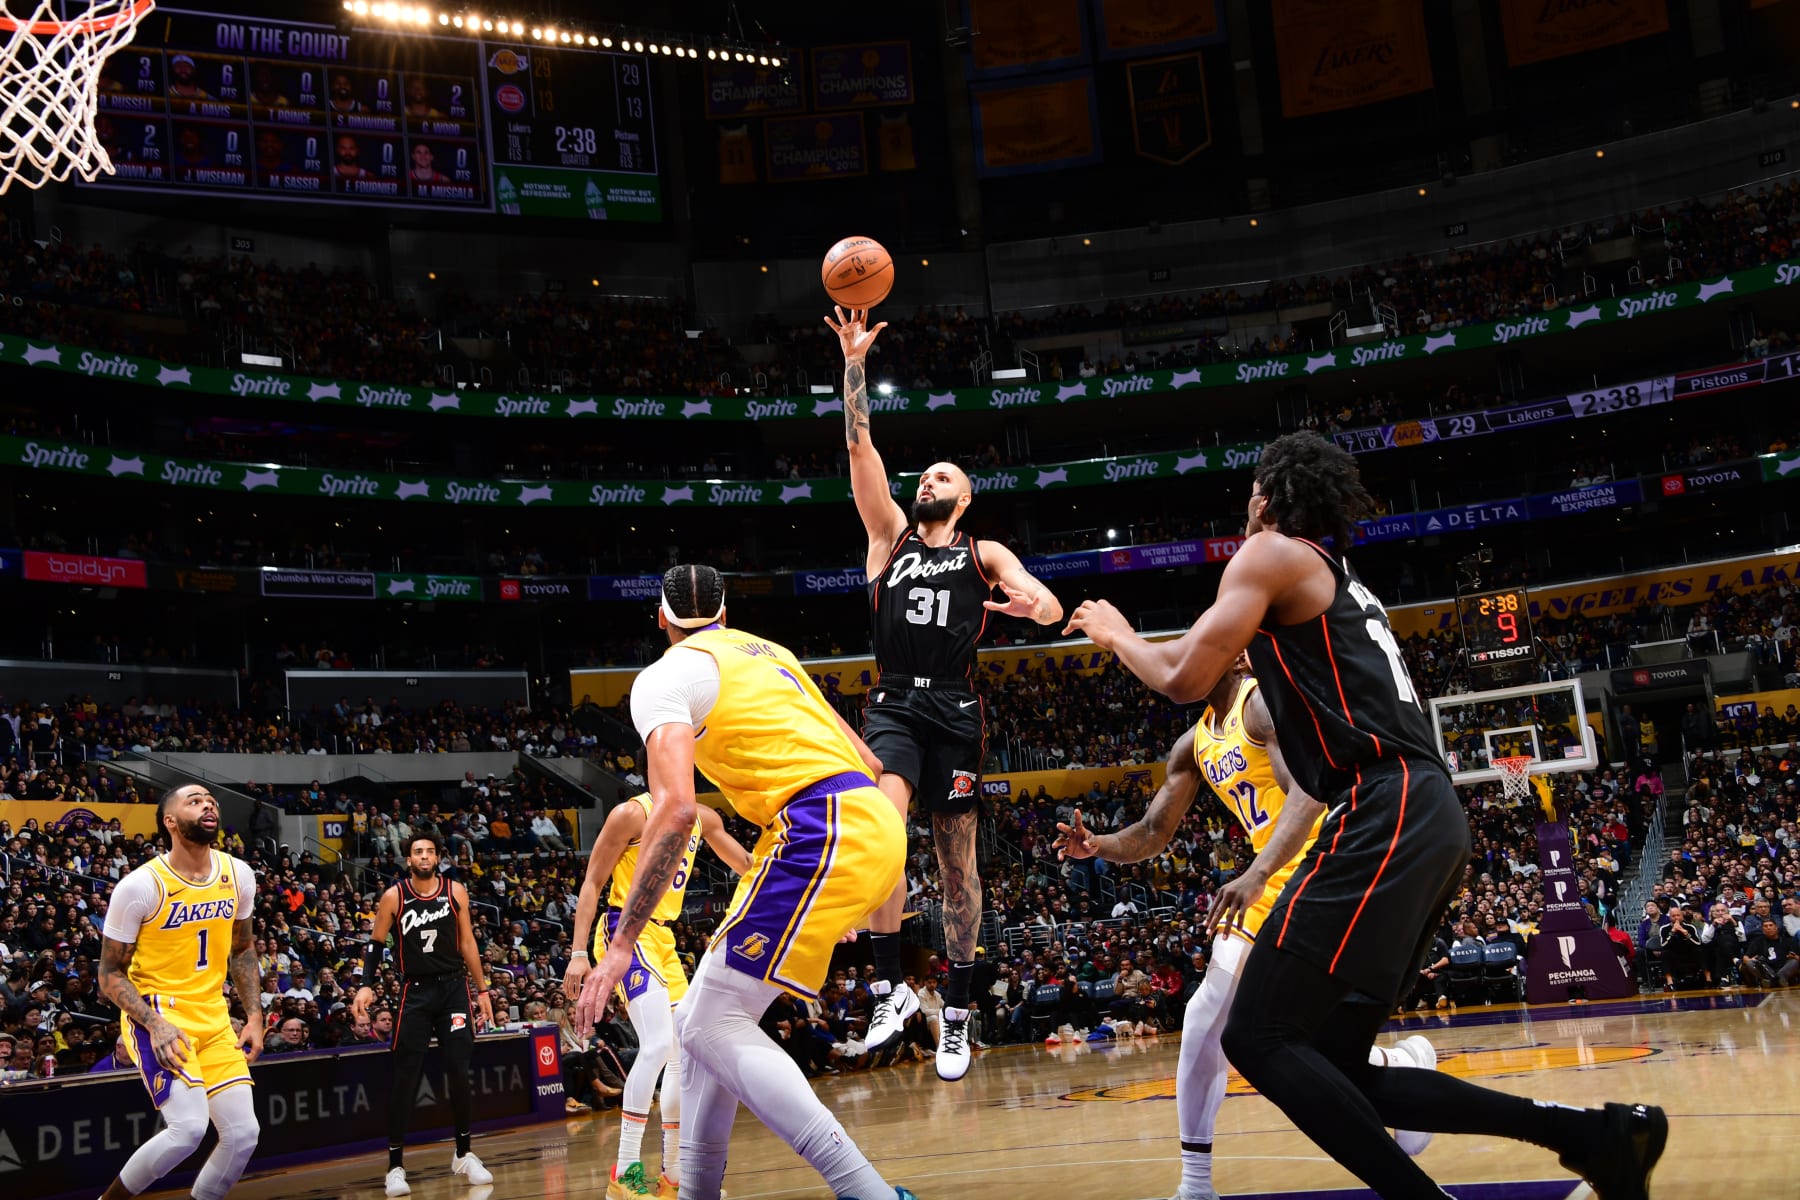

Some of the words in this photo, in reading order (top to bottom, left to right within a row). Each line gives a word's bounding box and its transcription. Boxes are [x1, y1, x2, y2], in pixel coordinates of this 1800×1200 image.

[216, 22, 245, 50] ON
[249, 26, 285, 55] THE
[288, 30, 350, 60] COURT
[139, 56, 151, 79] 3
[222, 64, 233, 86] 6
[622, 63, 640, 87] 29
[220, 86, 238, 99] PTS
[301, 71, 312, 94] 0
[377, 79, 389, 100] 0
[819, 73, 906, 95] CHAMPIONS
[111, 94, 154, 112] RUSSELL
[451, 84, 463, 106] 2
[201, 103, 232, 118] DAVIS
[626, 95, 643, 119] 13
[144, 124, 156, 147] 2
[226, 130, 239, 152] 0
[554, 125, 598, 155] 2:38
[305, 137, 318, 159] 0
[382, 142, 394, 163] 0
[456, 148, 468, 169] 0
[773, 145, 860, 166] CHAMPIONS
[195, 170, 246, 186] WISEMAN
[283, 176, 320, 191] SASSER
[355, 179, 398, 196] FOURNIER
[431, 185, 475, 201] MUSCALA
[234, 239, 251, 250] 303
[1616, 290, 1678, 319] Sprite
[1492, 316, 1550, 344] Sprite
[77, 350, 140, 381] Sprite
[1350, 341, 1406, 367] Sprite
[1236, 358, 1290, 384] Sprite
[1690, 371, 1749, 391] Pistons
[230, 373, 292, 400] Sprite
[355, 383, 413, 409] Sprite
[1100, 372, 1155, 398] Sprite
[1659, 386, 1669, 401] 1
[494, 394, 552, 418] Sprite
[612, 396, 666, 420] Sprite
[744, 398, 798, 421] Sprite
[868, 391, 910, 415] prite
[988, 386, 1042, 410] Sprite
[1581, 385, 1642, 416] 2:38
[1449, 414, 1477, 438] 29
[1507, 405, 1555, 425] Lakers
[21, 440, 89, 470] Sprite
[1345, 440, 1355, 453] 7
[1367, 437, 1377, 450] 0
[1103, 457, 1160, 482] Sprite
[1222, 446, 1262, 471] Spri
[160, 459, 223, 487] Sprite
[318, 472, 380, 497] Sprite
[969, 472, 1020, 495] Sprite
[1687, 470, 1742, 487] TOYOTA
[444, 481, 501, 505] Sprite
[589, 483, 647, 507] Sprite
[708, 483, 764, 507] Sprite
[1551, 486, 1615, 506] AMERICAN
[1561, 495, 1617, 513] EXPRESS
[1448, 503, 1520, 527] DELTA
[1366, 520, 1411, 538] ULTRA
[47, 557, 127, 583] boldyn
[887, 551, 968, 588] Detroit
[1025, 558, 1091, 575] crypto.com
[264, 571, 310, 584] Columbia
[312, 574, 335, 584] West
[337, 574, 373, 586] College
[425, 577, 472, 597] Sprite
[523, 584, 572, 596] TOYOTA
[611, 577, 663, 589] AMERICA
[806, 572, 868, 592] Spectru
[905, 586, 951, 628] 31
[1479, 593, 1518, 616] 2:38
[1496, 612, 1518, 644] 9
[1489, 645, 1531, 661] TISSOT
[913, 677, 932, 689] DET
[1651, 667, 1688, 682] TOYOTA
[1203, 745, 1248, 785] LAKERS
[983, 782, 1008, 795] 106
[1228, 779, 1271, 833] 12
[160, 897, 236, 930] LAKERS
[1546, 901, 1581, 910] PECHANGA
[400, 902, 451, 937] Detroit
[195, 927, 209, 971] 1
[420, 928, 438, 953] 7
[1491, 946, 1513, 954] DELTA
[1456, 949, 1478, 957] DELTA
[1548, 968, 1596, 980] PECHANGA
[1550, 977, 1573, 985] RESORT
[536, 1081, 565, 1097] TOYOTA
[268, 1083, 370, 1127] DELTA
